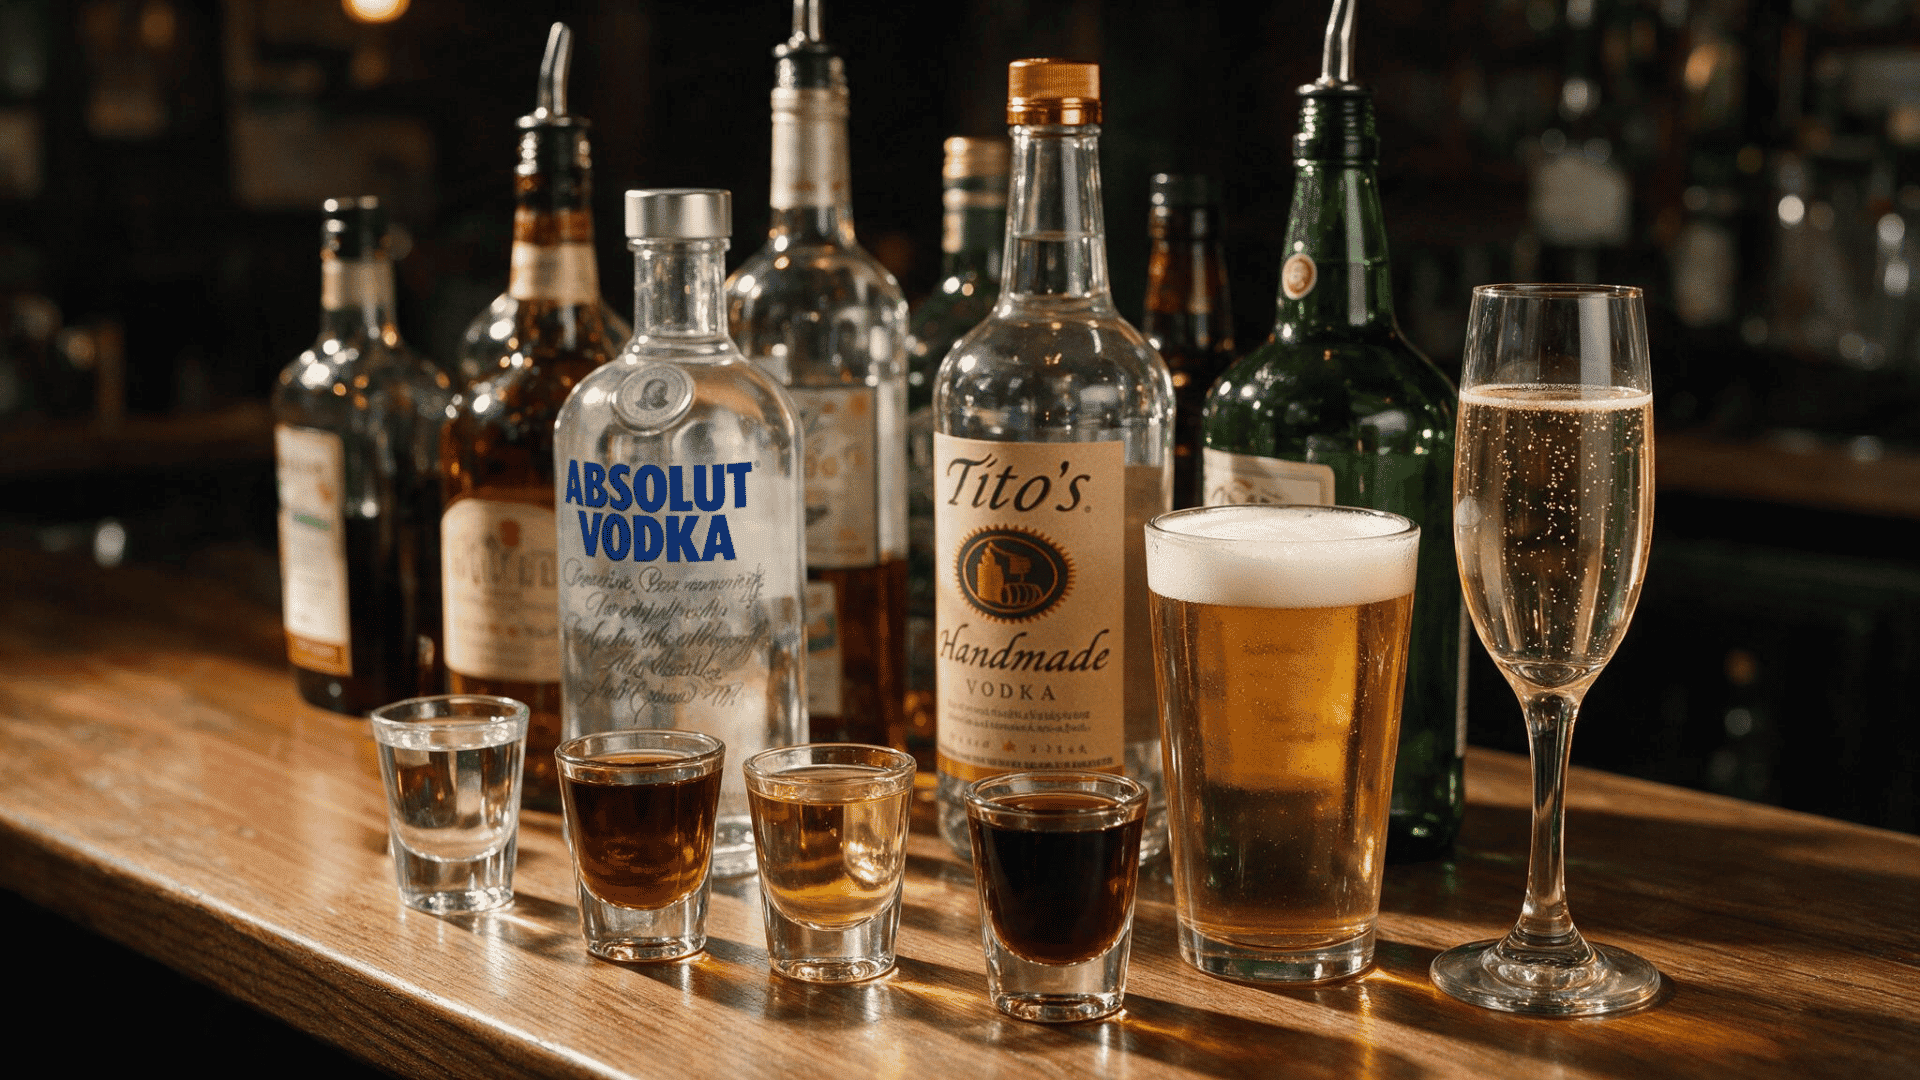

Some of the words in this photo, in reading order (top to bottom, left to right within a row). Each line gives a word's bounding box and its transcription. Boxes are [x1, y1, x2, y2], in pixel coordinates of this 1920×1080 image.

[566, 459, 752, 513] ABSOLUT
[947, 453, 1090, 512] Tito's
[578, 510, 736, 562] VODKA
[940, 624, 1109, 672] Handmade
[966, 679, 1056, 702] VODKA
